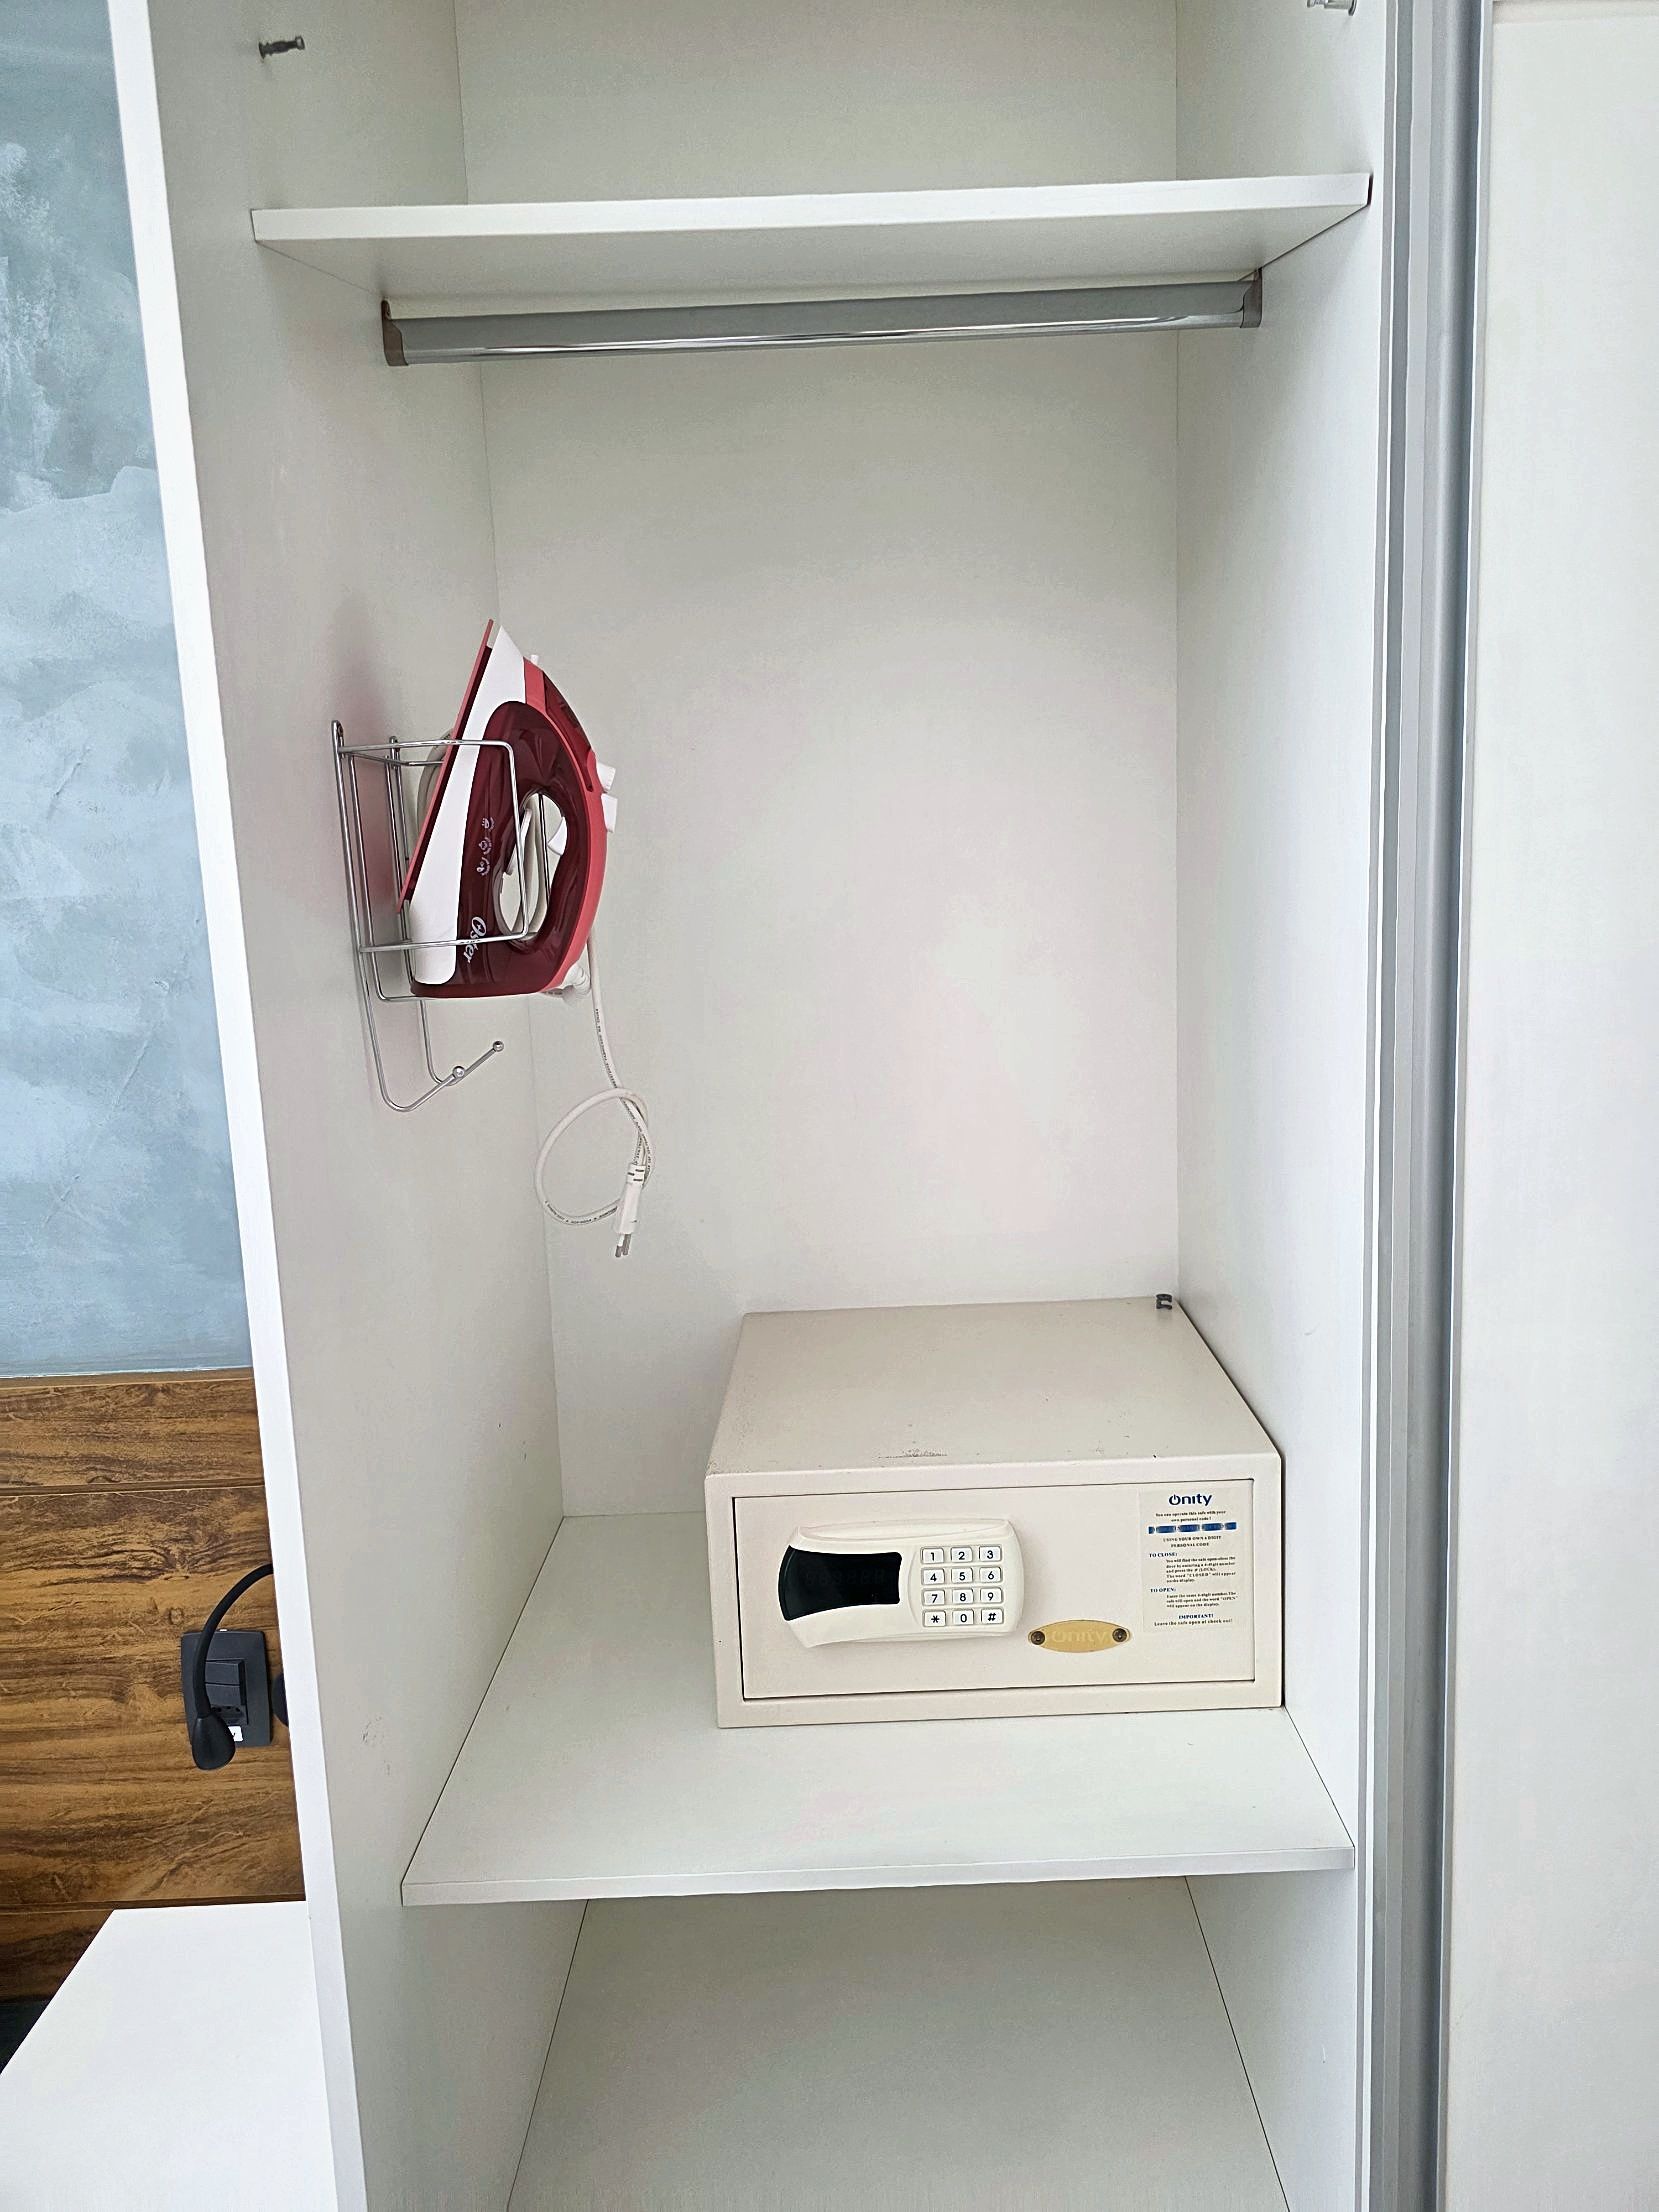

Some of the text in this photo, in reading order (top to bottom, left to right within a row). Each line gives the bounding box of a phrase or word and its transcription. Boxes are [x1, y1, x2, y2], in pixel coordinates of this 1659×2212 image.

[1169, 1494, 1212, 1506] Onity
[930, 1550, 993, 1561] 1 2 3
[930, 1571, 994, 1582] 4 5 6
[931, 1592, 994, 1603] 7 8 9
[960, 1614, 967, 1623] 0
[988, 1612, 996, 1621] #
